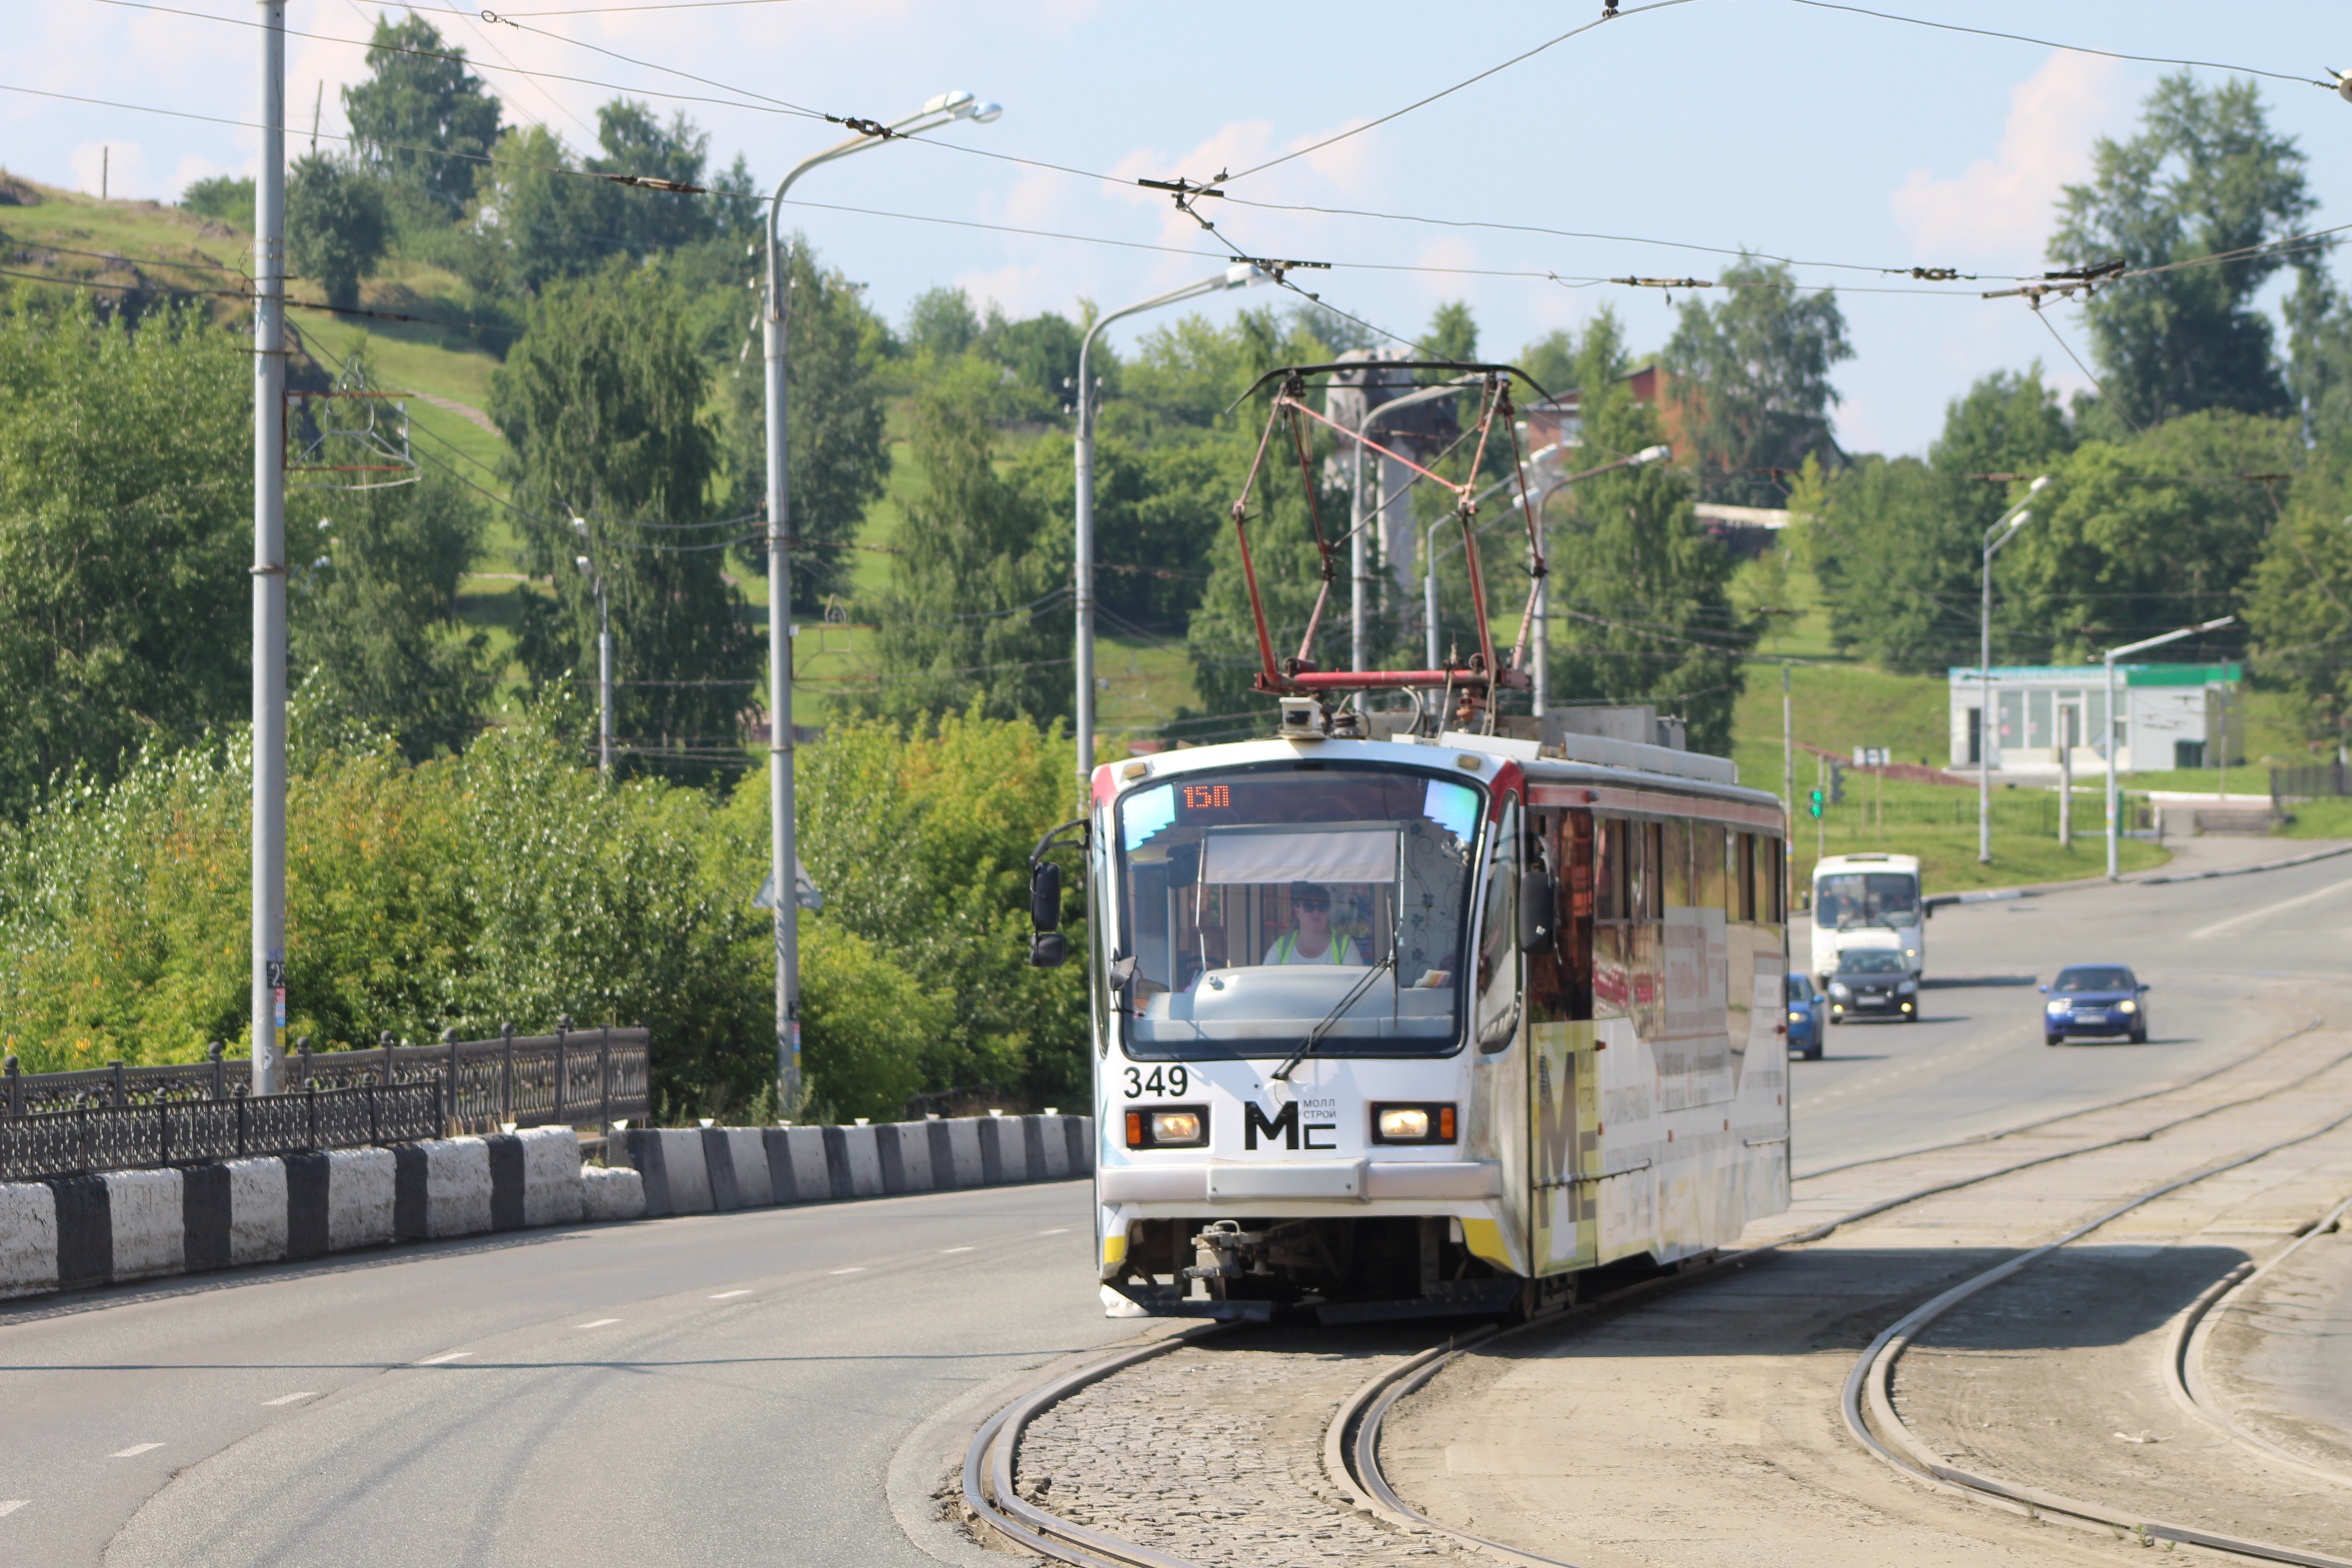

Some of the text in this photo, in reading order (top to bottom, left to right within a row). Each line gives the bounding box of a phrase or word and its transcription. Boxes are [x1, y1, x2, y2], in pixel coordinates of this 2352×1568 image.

[1183, 785, 1229, 808] 15П
[1124, 1065, 1187, 1098] 349
[1303, 1099, 1335, 1107] МОЛЛ
[1303, 1108, 1336, 1119] СТРОЙ
